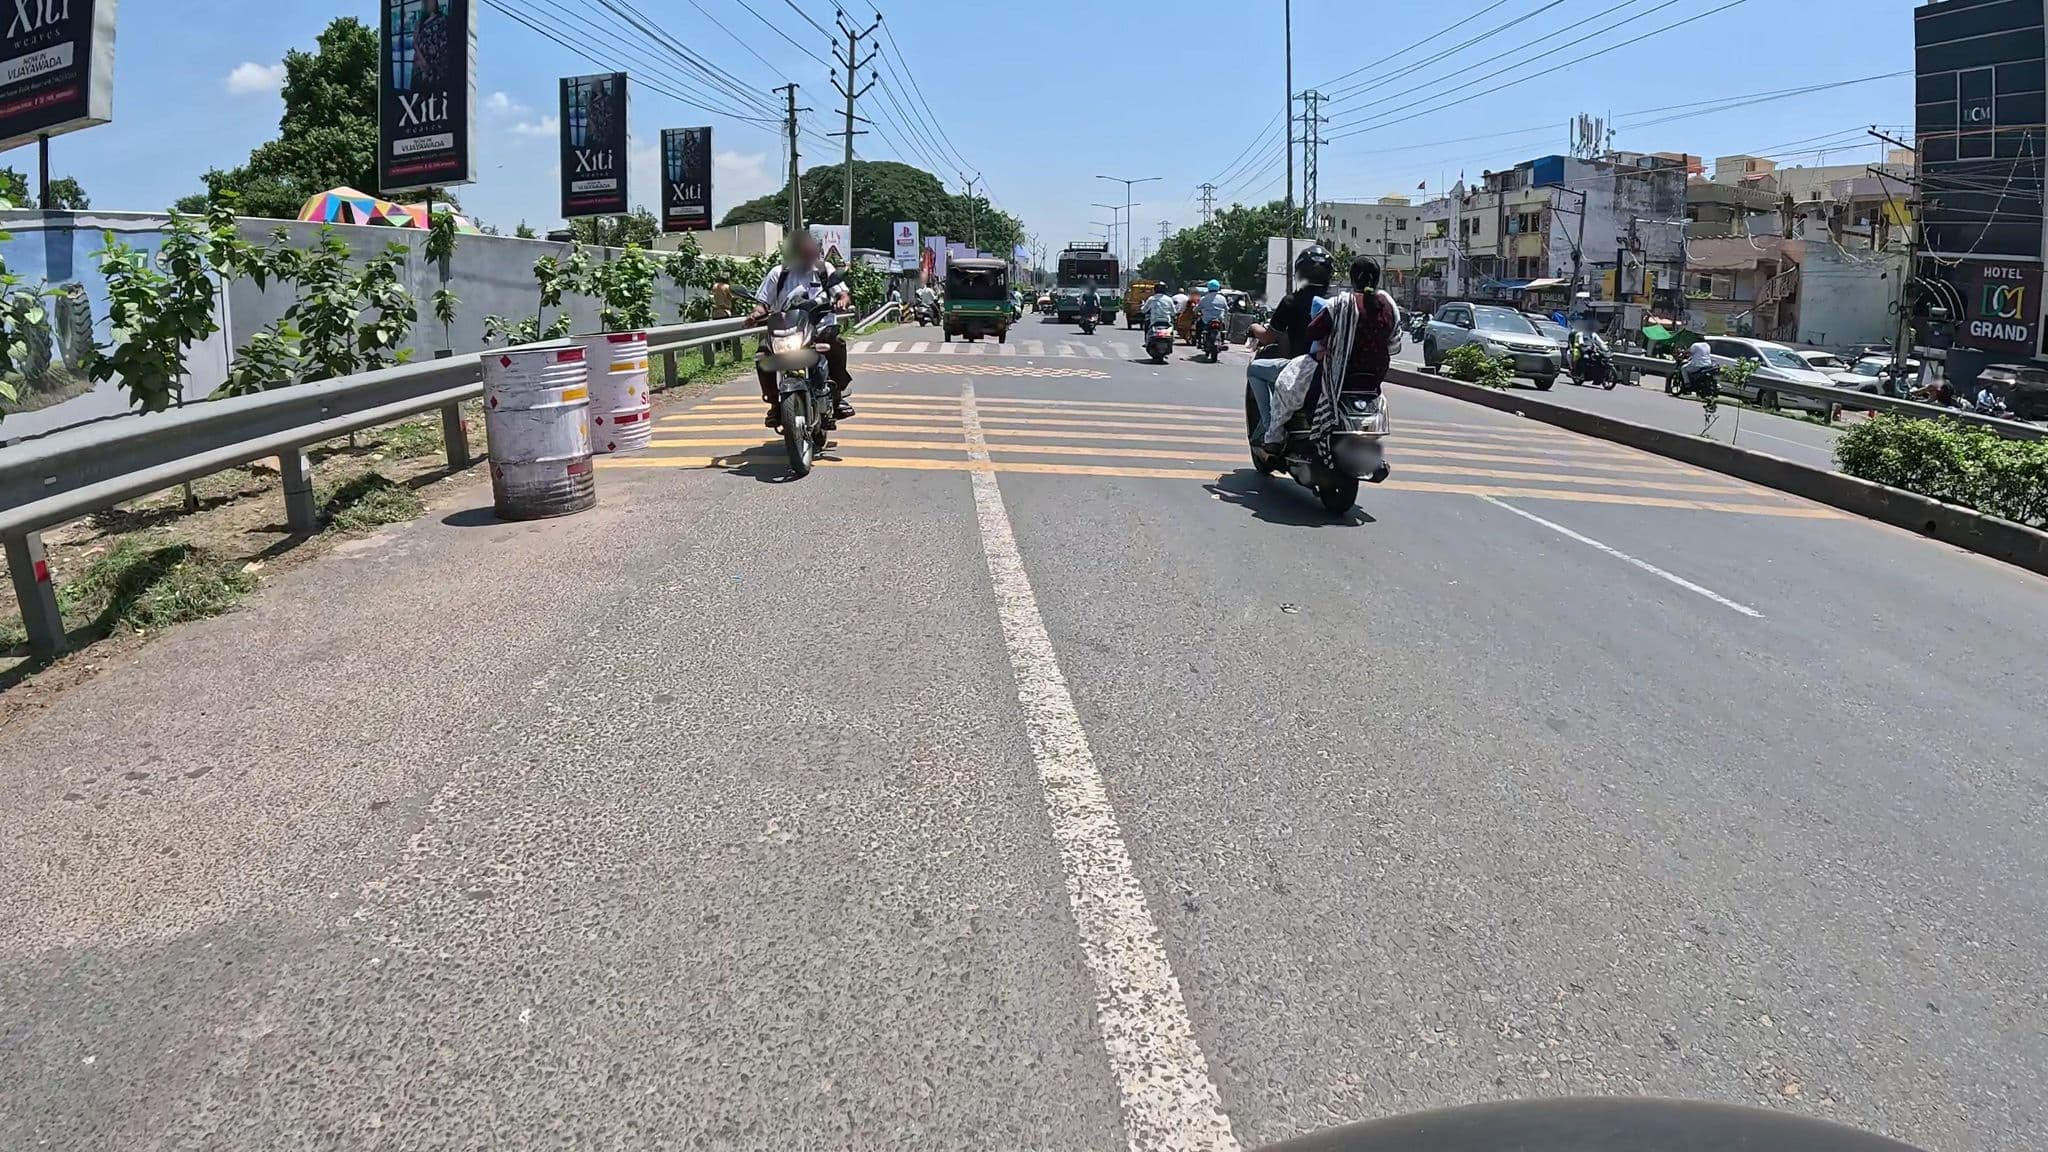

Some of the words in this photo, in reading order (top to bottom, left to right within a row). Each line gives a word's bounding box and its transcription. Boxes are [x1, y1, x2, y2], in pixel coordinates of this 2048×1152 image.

[7, 56, 62, 80] VIJAYAWADA
[398, 91, 448, 127] Xiti
[575, 149, 613, 172] Xiti
[673, 183, 701, 200] Xiti
[1984, 267, 2023, 279] HOTEL
[1980, 284, 2024, 319] DCM
[1970, 321, 2028, 341] GRAND
